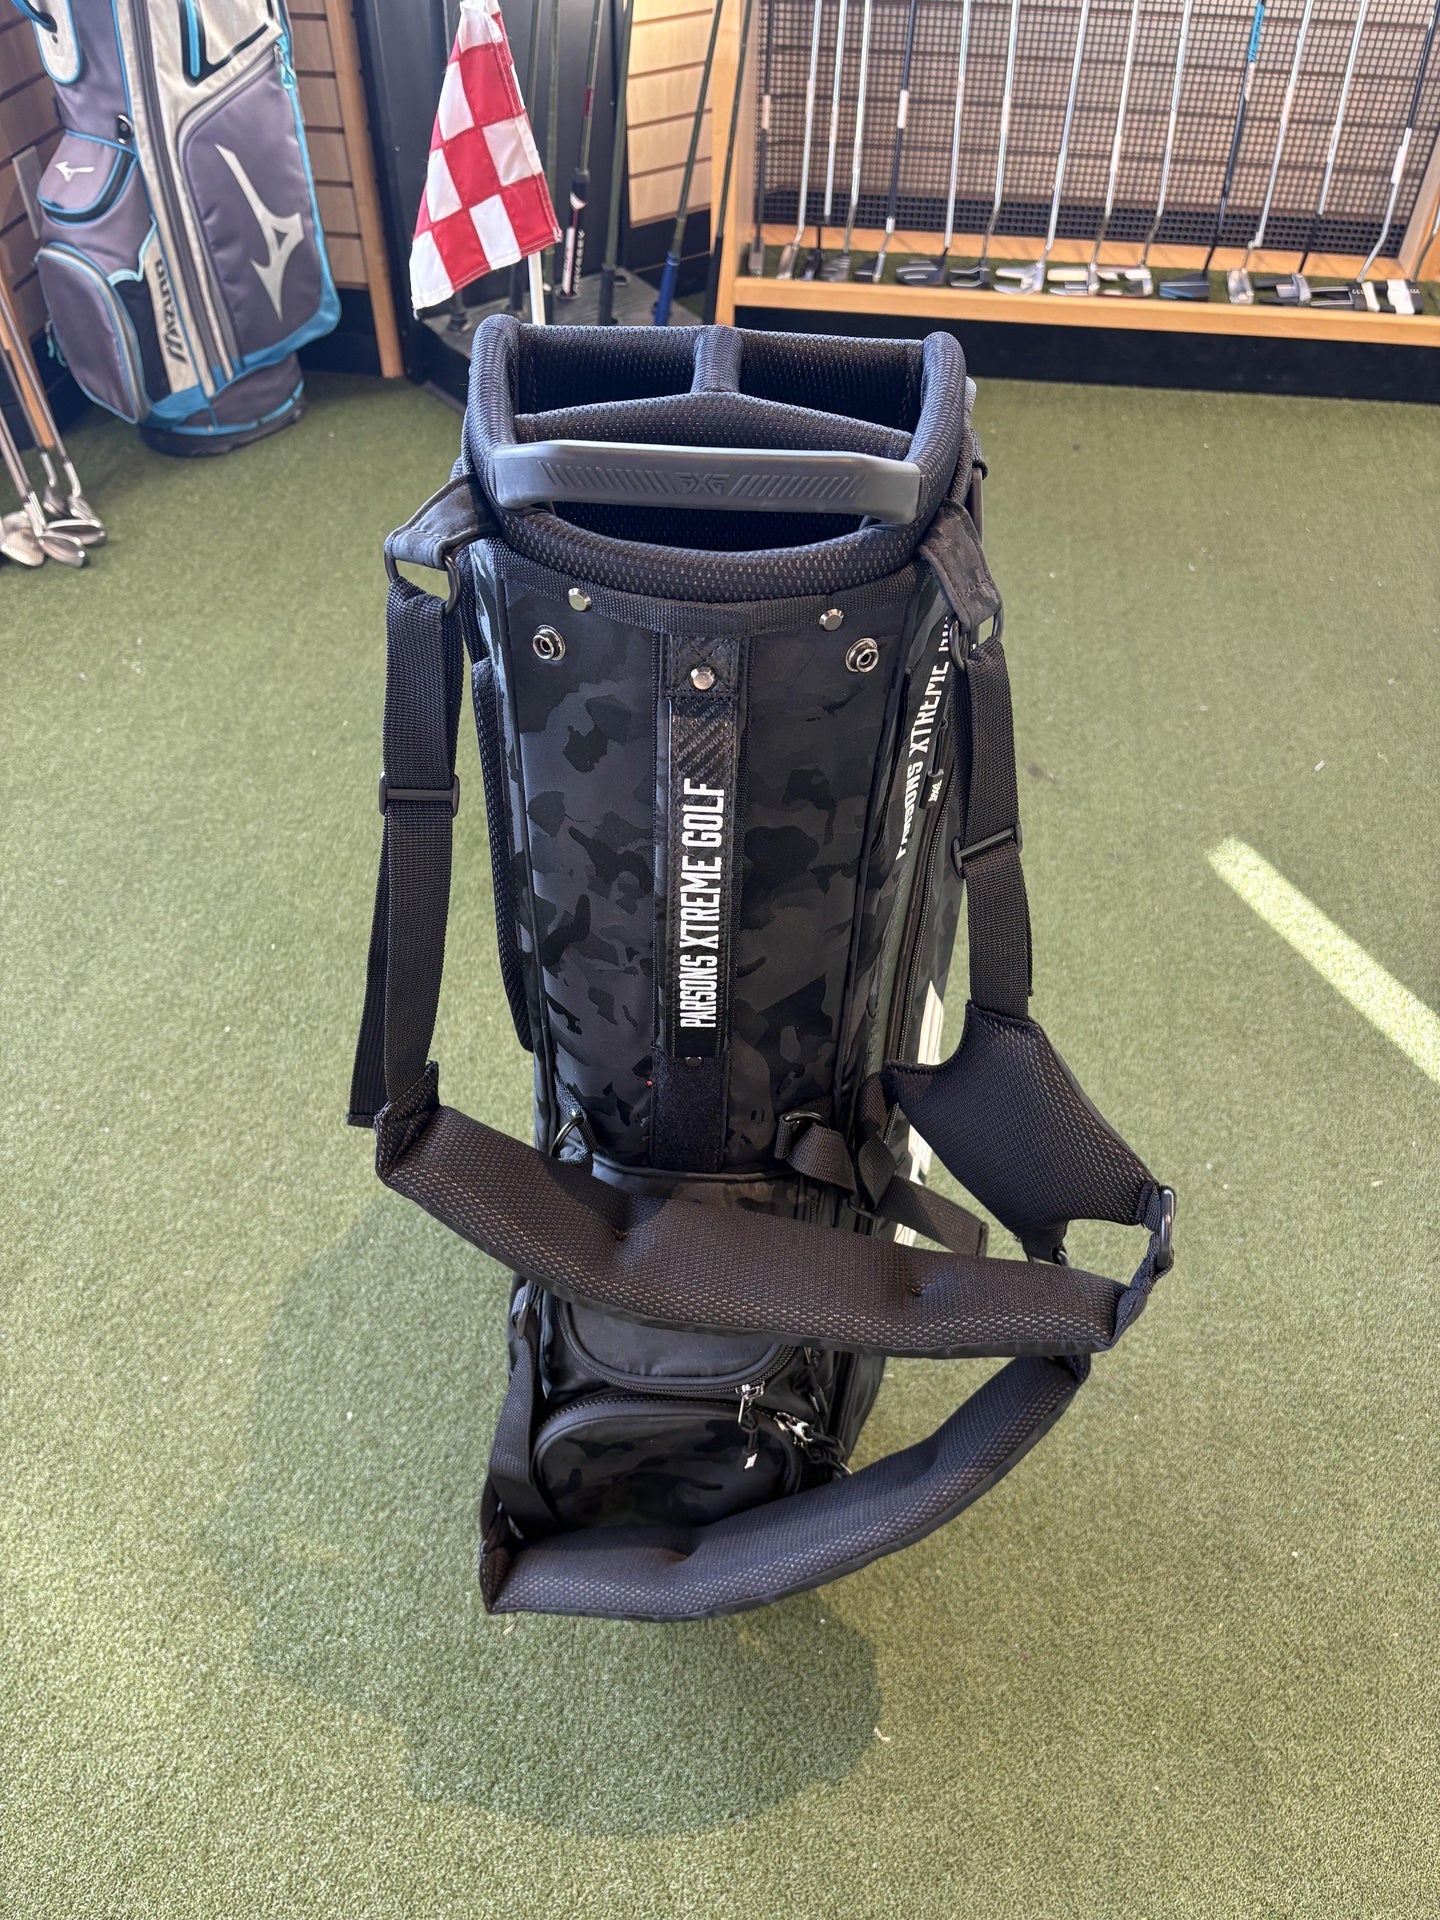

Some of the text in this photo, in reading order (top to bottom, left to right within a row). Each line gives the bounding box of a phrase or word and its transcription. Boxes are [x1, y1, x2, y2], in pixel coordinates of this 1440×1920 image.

[674, 472, 730, 495] PXG
[680, 779, 724, 1027] PARSONS XTREME GOLF
